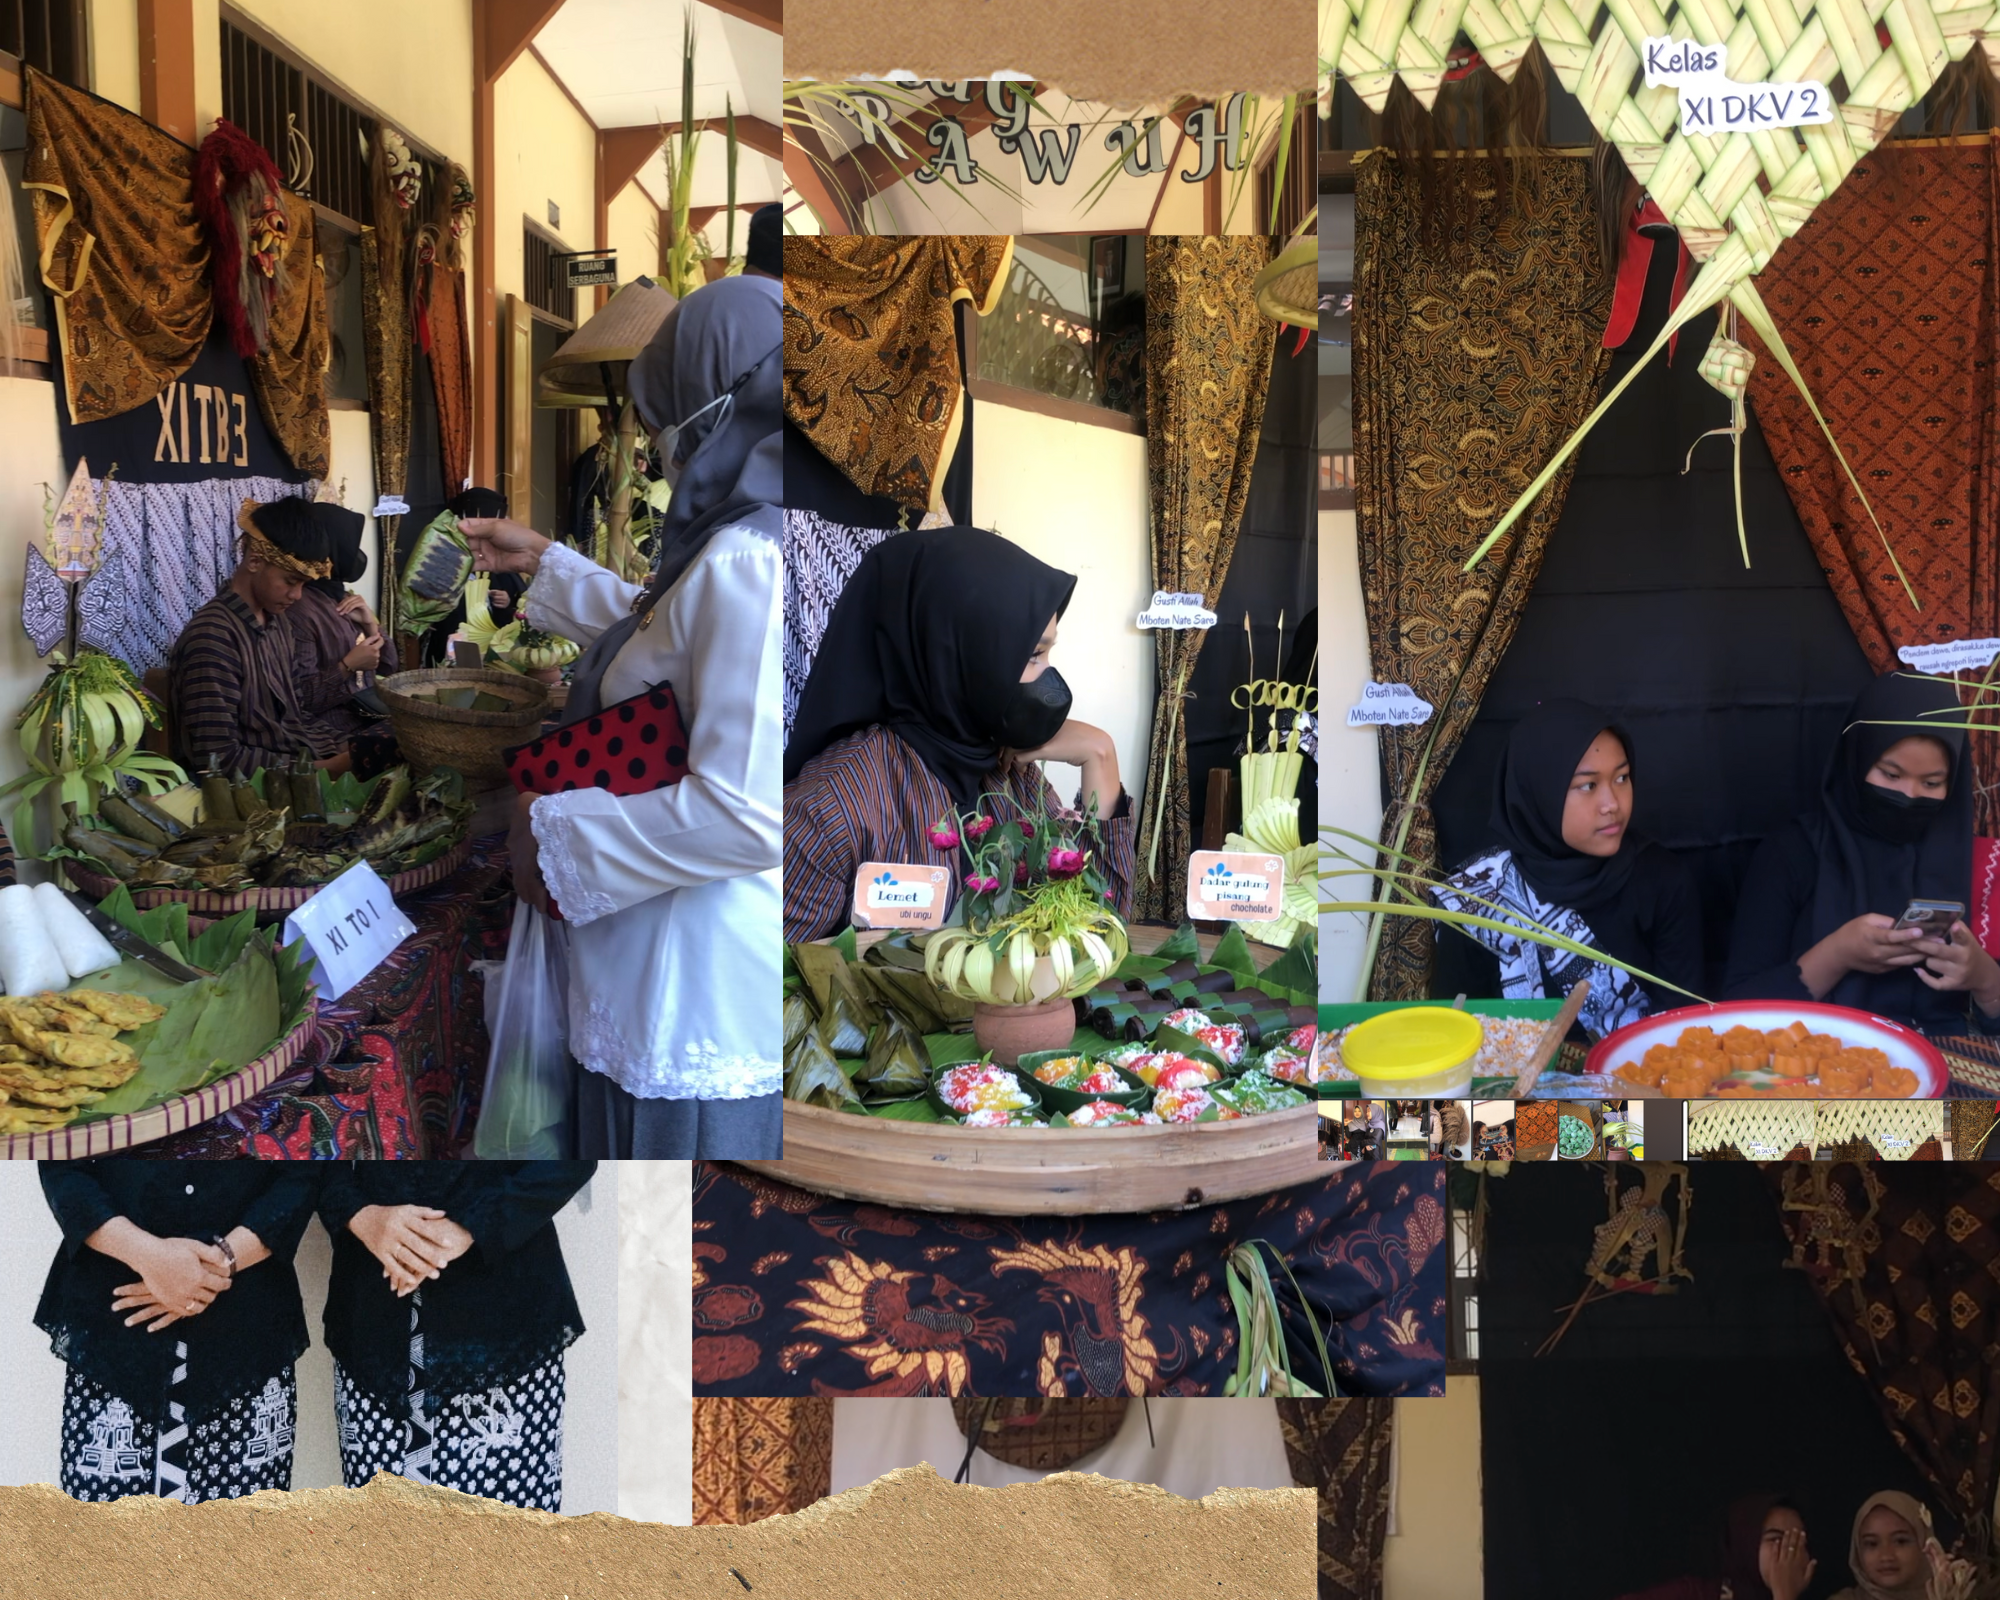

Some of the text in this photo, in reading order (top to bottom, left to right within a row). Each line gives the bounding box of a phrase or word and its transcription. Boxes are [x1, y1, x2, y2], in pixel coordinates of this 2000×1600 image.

[1648, 43, 1718, 73] Kelas
[1685, 89, 1820, 126] XI DKV 2
[578, 260, 606, 272] RUANG
[569, 272, 616, 286] SERBAGUNA
[1154, 594, 1199, 606] Gusti Allah
[1139, 613, 1215, 625] Mboten Nate Sare
[1366, 685, 1390, 699] Gusti
[1351, 706, 1430, 722] Mboten Nate Sare
[1200, 877, 1270, 891] Dadar gulung
[878, 890, 918, 903] Lemet
[1217, 891, 1251, 903] pisang
[1230, 903, 1274, 914] chocholate
[899, 910, 932, 922] ubi ungu
[325, 925, 349, 956] XI
[344, 908, 371, 936] TO
